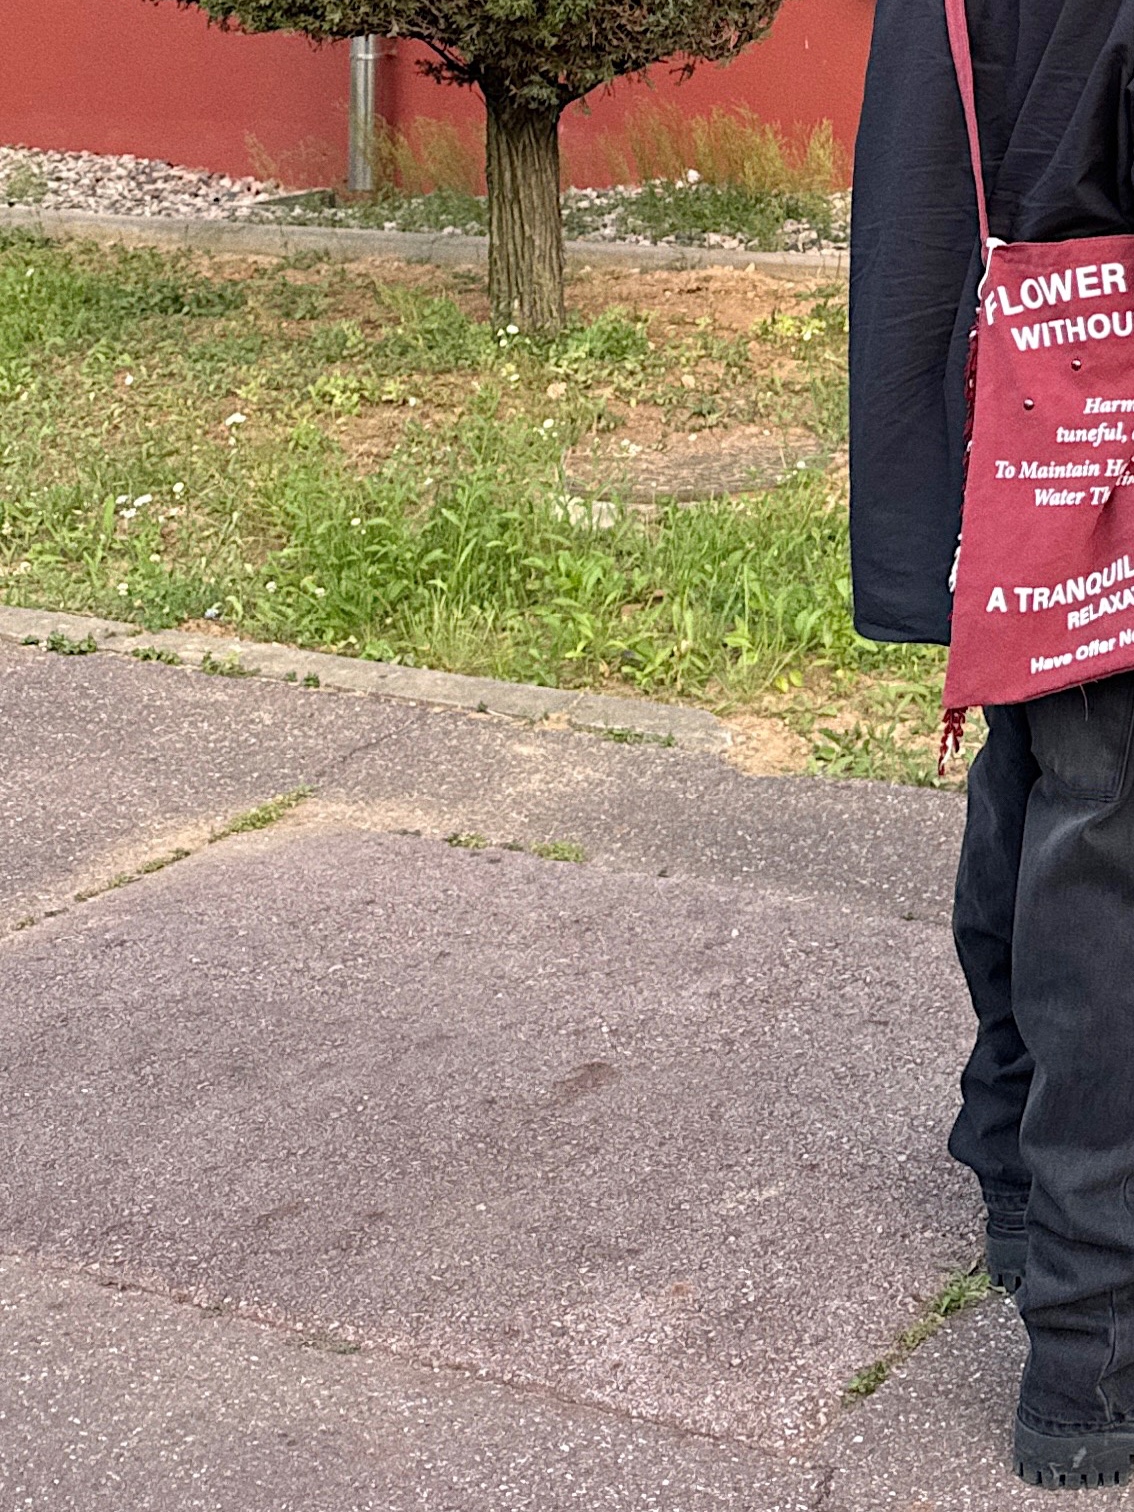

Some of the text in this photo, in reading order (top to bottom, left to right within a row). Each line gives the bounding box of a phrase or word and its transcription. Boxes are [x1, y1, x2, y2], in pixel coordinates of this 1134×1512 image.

[984, 261, 1127, 326] FLOWER
[1056, 421, 1127, 447] tuneful,
[994, 460, 1015, 479] To
[1018, 458, 1101, 479] Maintain
[1034, 486, 1085, 507] Water
[986, 586, 1008, 613] A
[1031, 652, 1073, 675] Have
[1075, 638, 1117, 661] Offer
